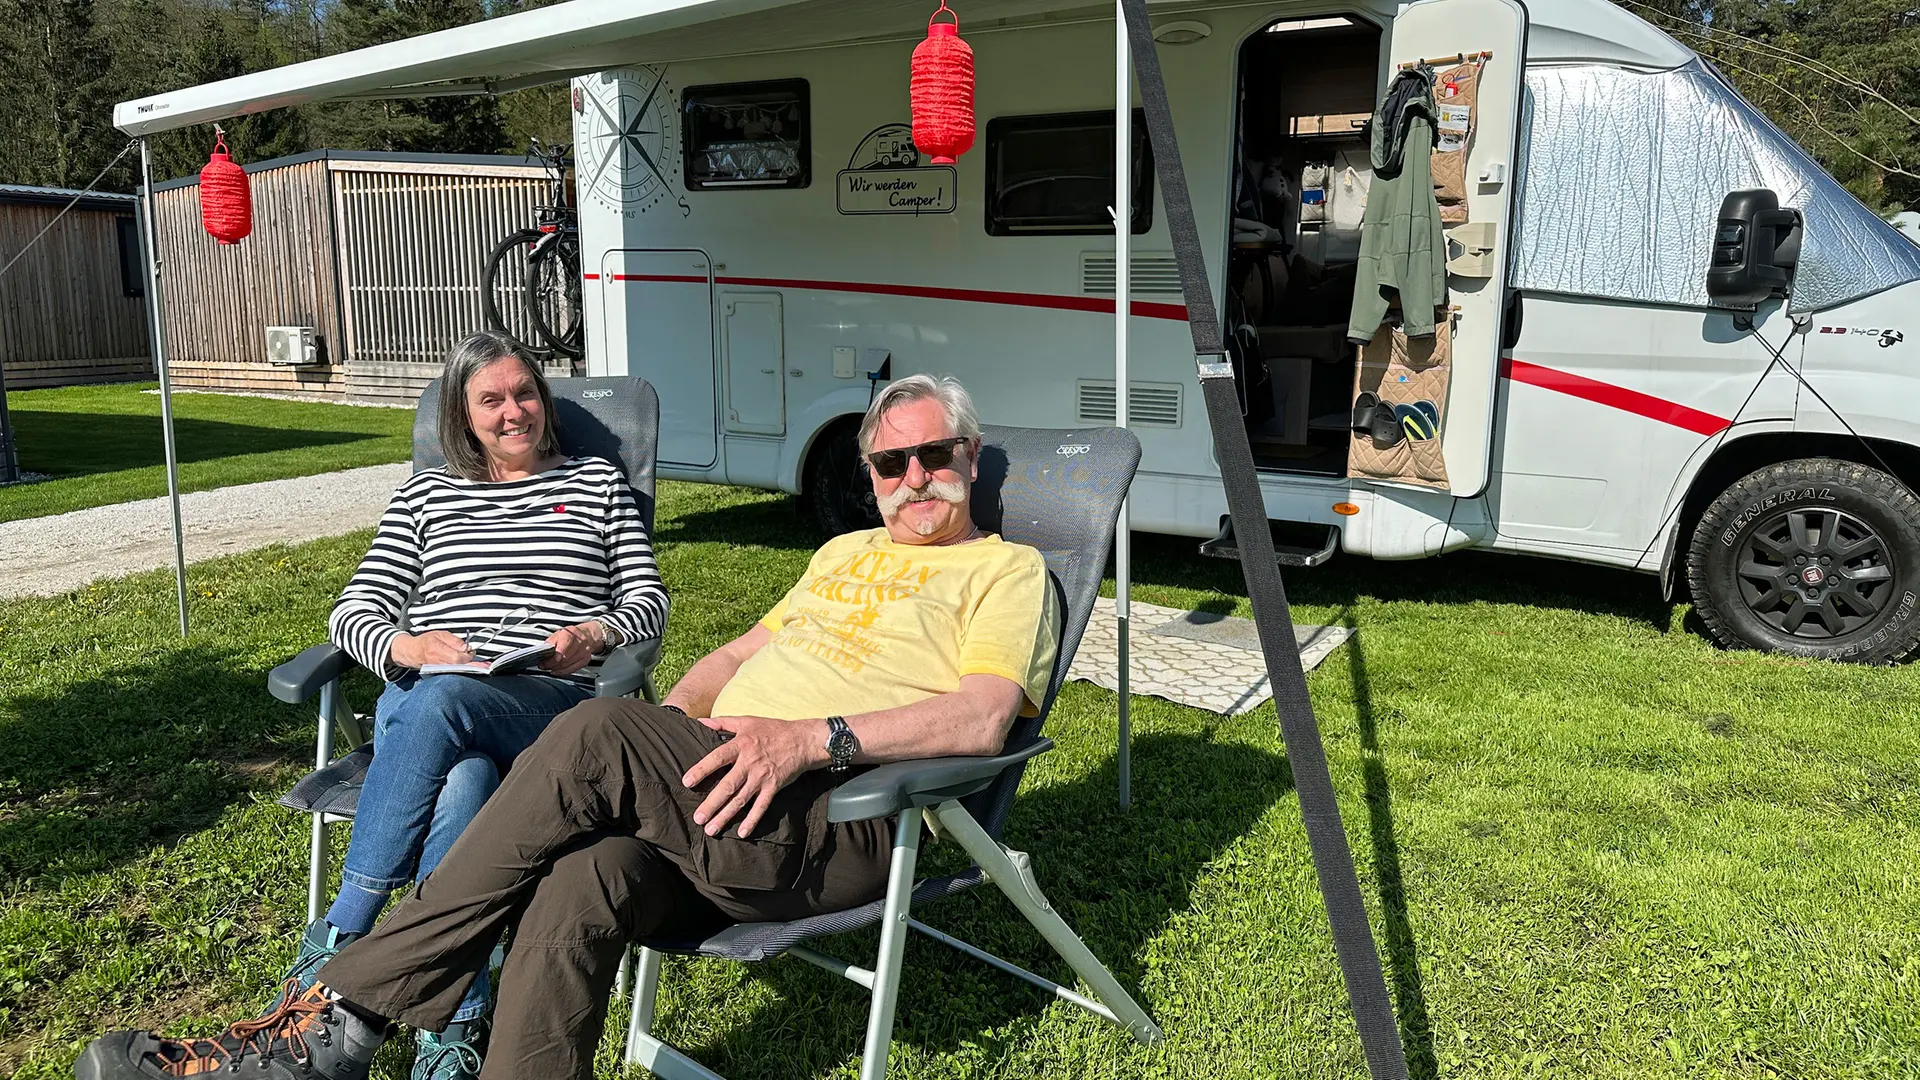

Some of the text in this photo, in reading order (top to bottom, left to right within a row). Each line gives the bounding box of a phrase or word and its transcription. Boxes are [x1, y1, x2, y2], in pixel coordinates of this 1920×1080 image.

[137, 104, 154, 114] THULE
[849, 176, 917, 192] Wir werden
[1721, 487, 1836, 547] GENERAL
